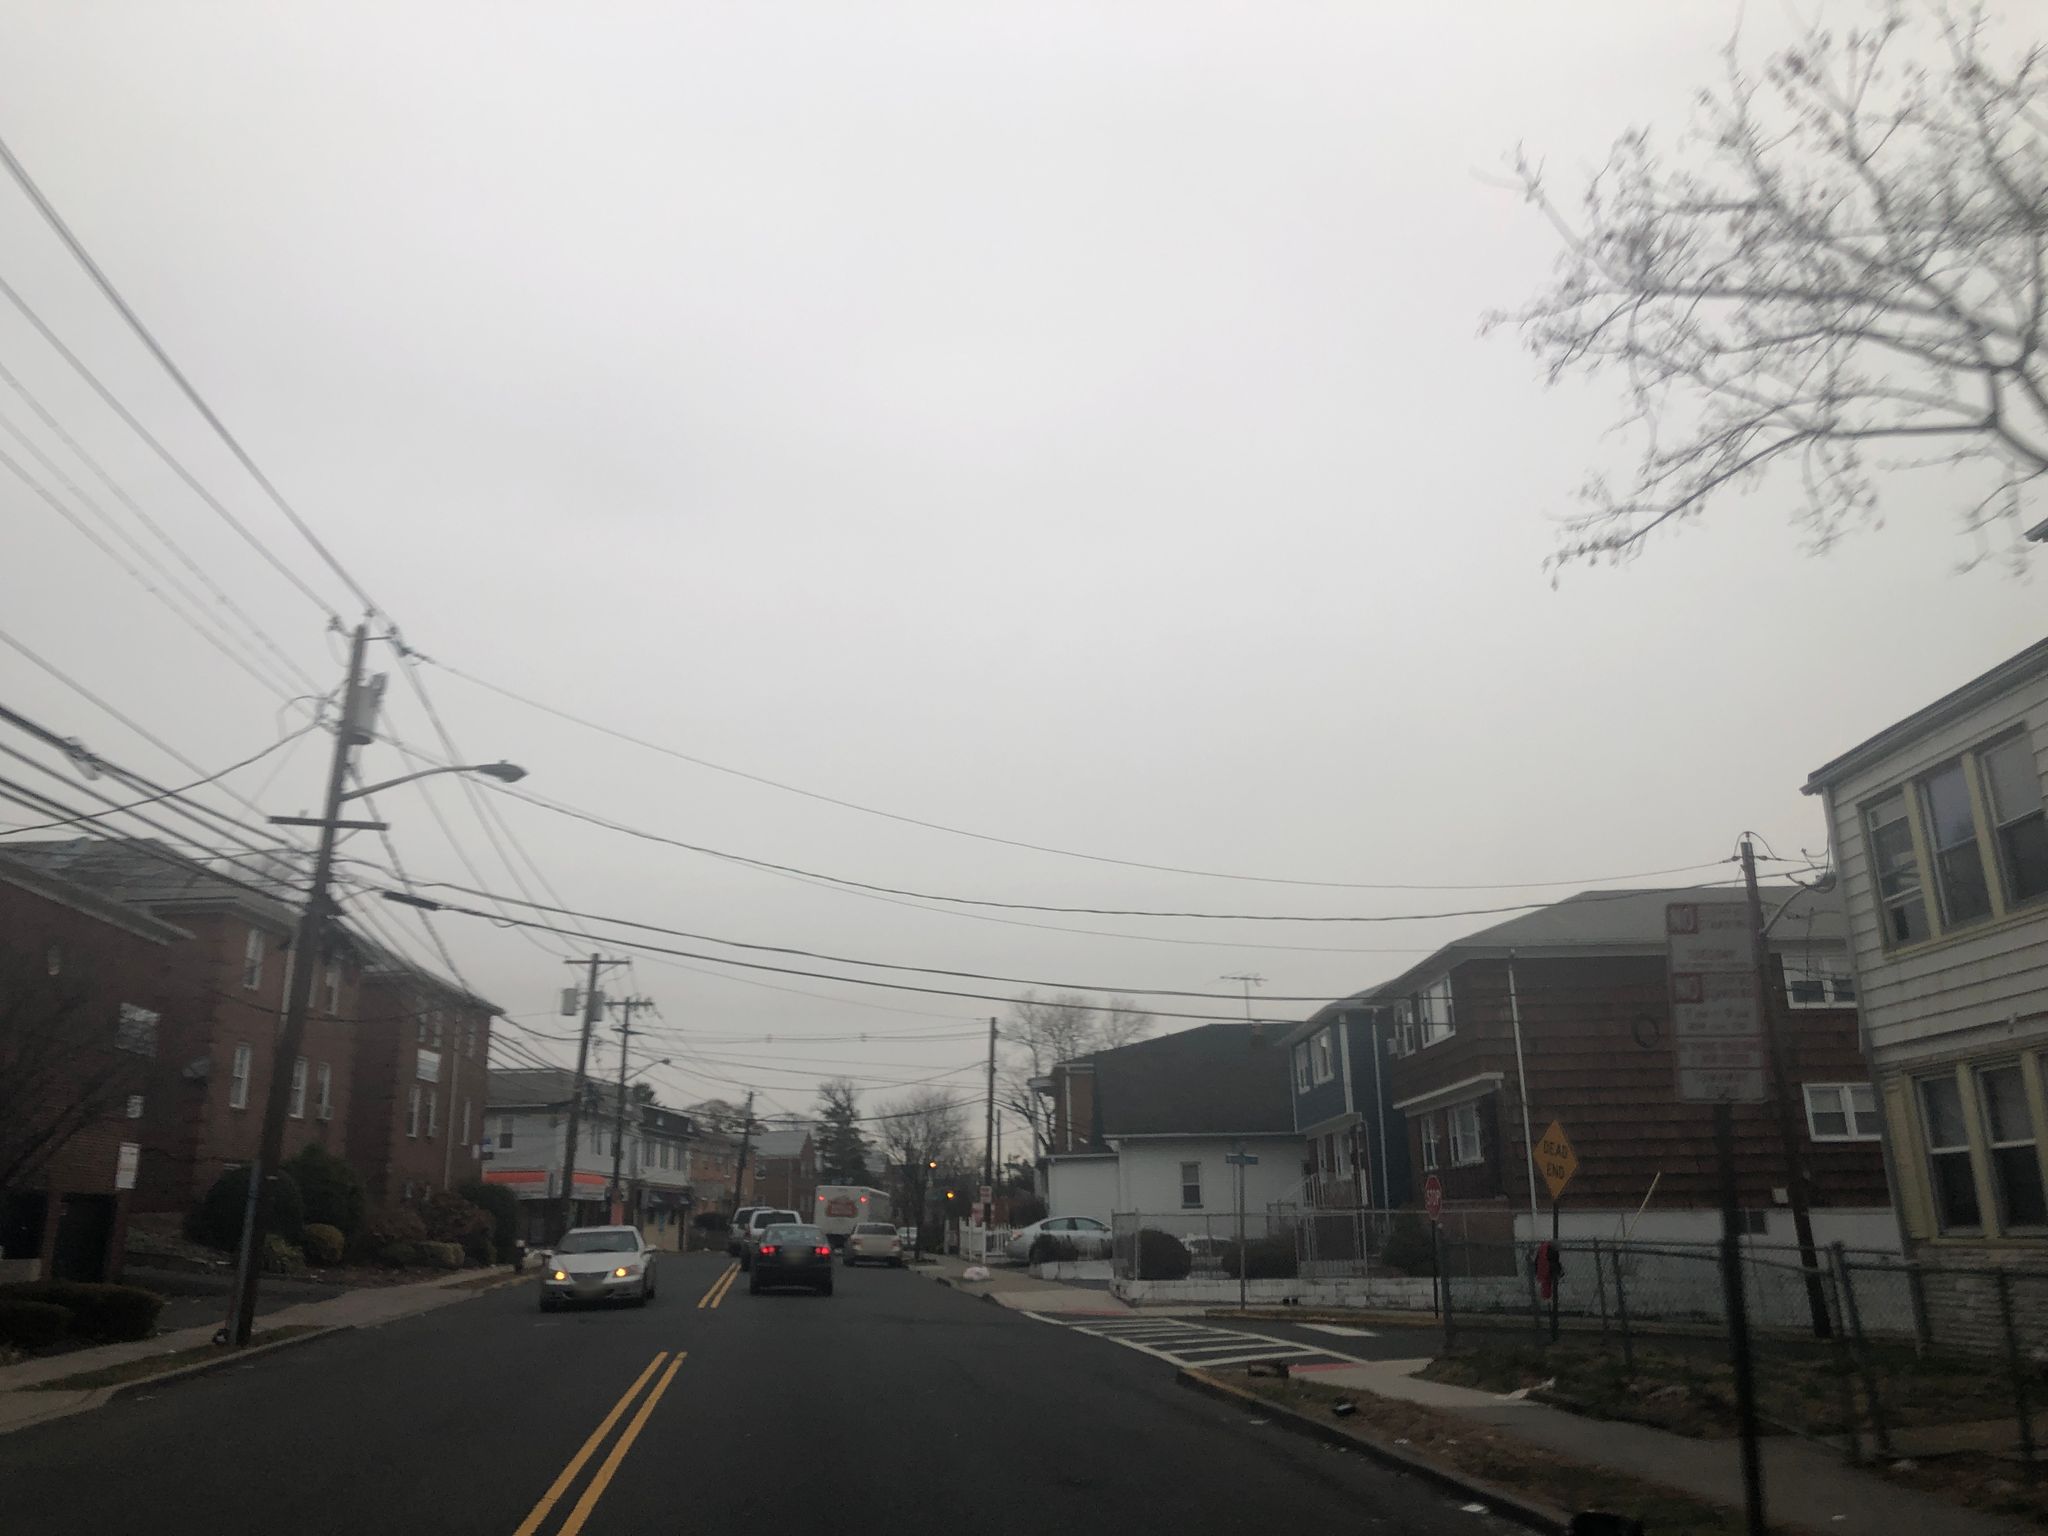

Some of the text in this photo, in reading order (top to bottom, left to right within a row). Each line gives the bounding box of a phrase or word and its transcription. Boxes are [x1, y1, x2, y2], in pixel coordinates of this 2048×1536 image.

[1543, 1140, 1568, 1159] DEAD
[1546, 1163, 1565, 1179] END
[1426, 1189, 1442, 1206] STOP
